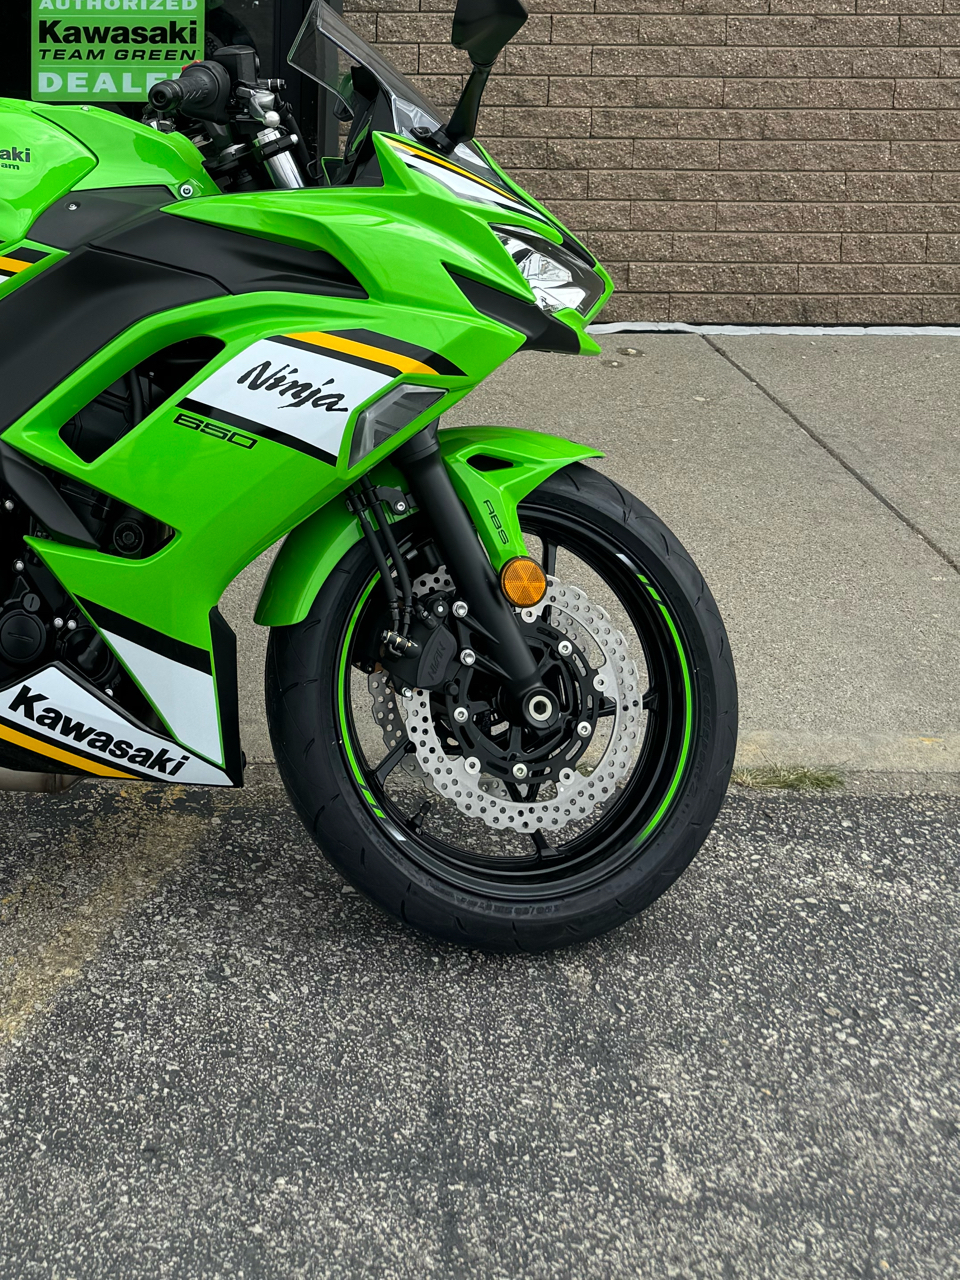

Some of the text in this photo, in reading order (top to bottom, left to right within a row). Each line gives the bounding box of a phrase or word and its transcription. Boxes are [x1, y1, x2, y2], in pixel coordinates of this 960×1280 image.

[38, 20, 197, 45] Kawasaki
[38, 49, 197, 61] TEAM GREEN
[38, 72, 181, 93] DEALE
[237, 361, 349, 412] Ninja
[173, 413, 258, 450] 650
[483, 499, 510, 545] ABS
[7, 684, 191, 777] Kawasaki
